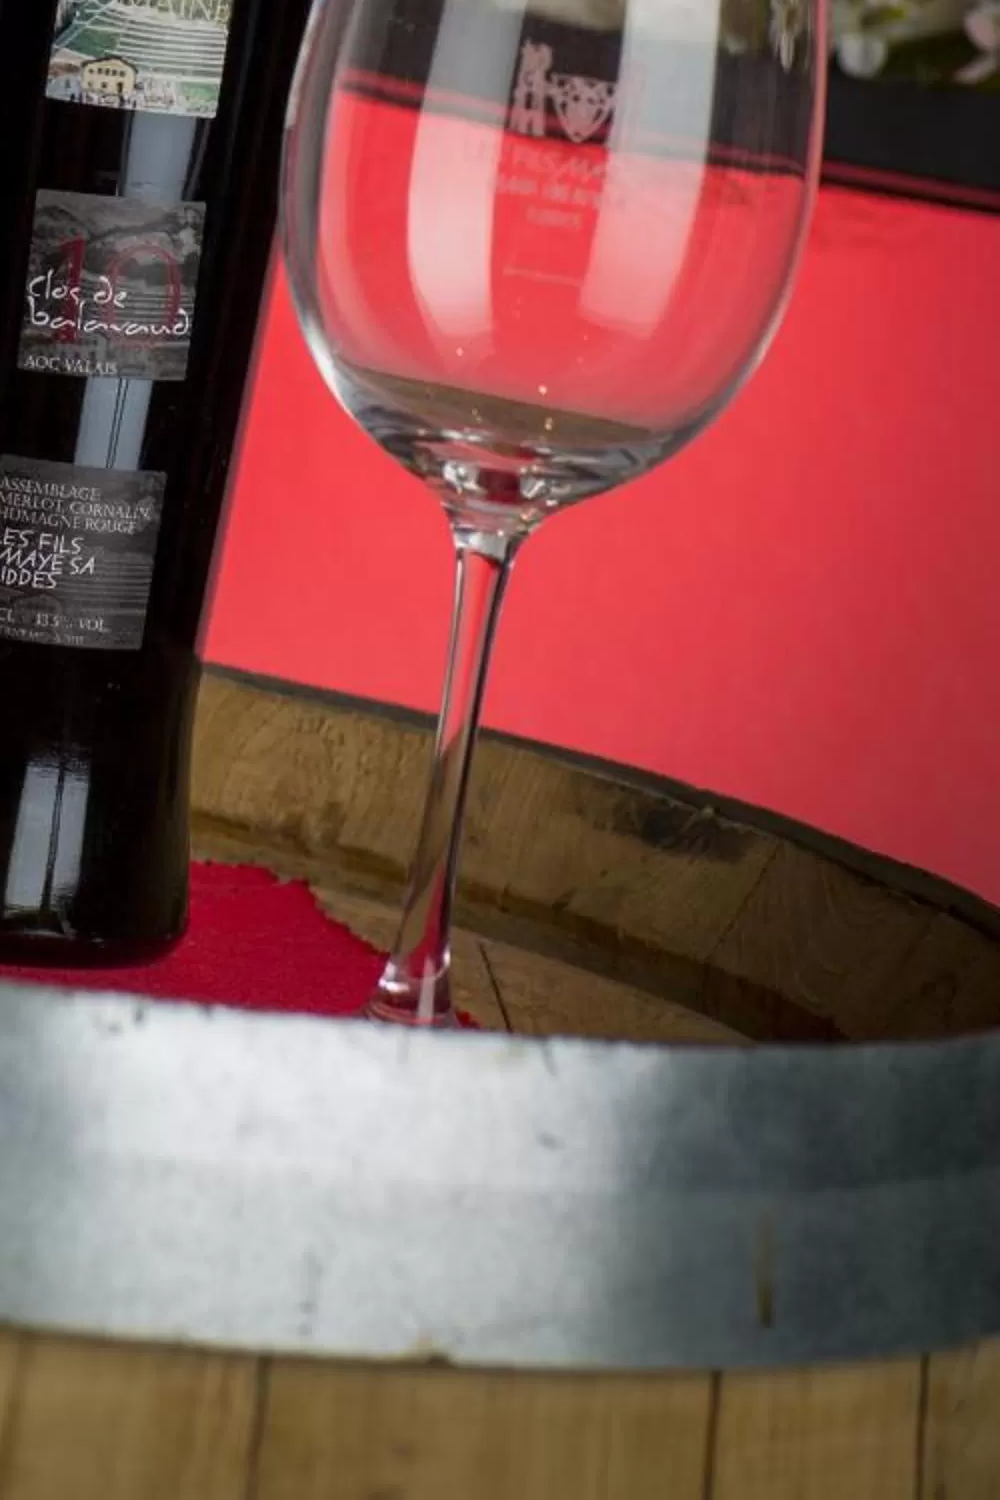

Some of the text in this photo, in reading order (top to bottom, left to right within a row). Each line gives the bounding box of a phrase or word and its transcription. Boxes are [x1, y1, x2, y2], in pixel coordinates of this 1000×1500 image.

[84, 516, 138, 536] ROUGE
[38, 531, 85, 556] FILS
[68, 555, 97, 576] SA
